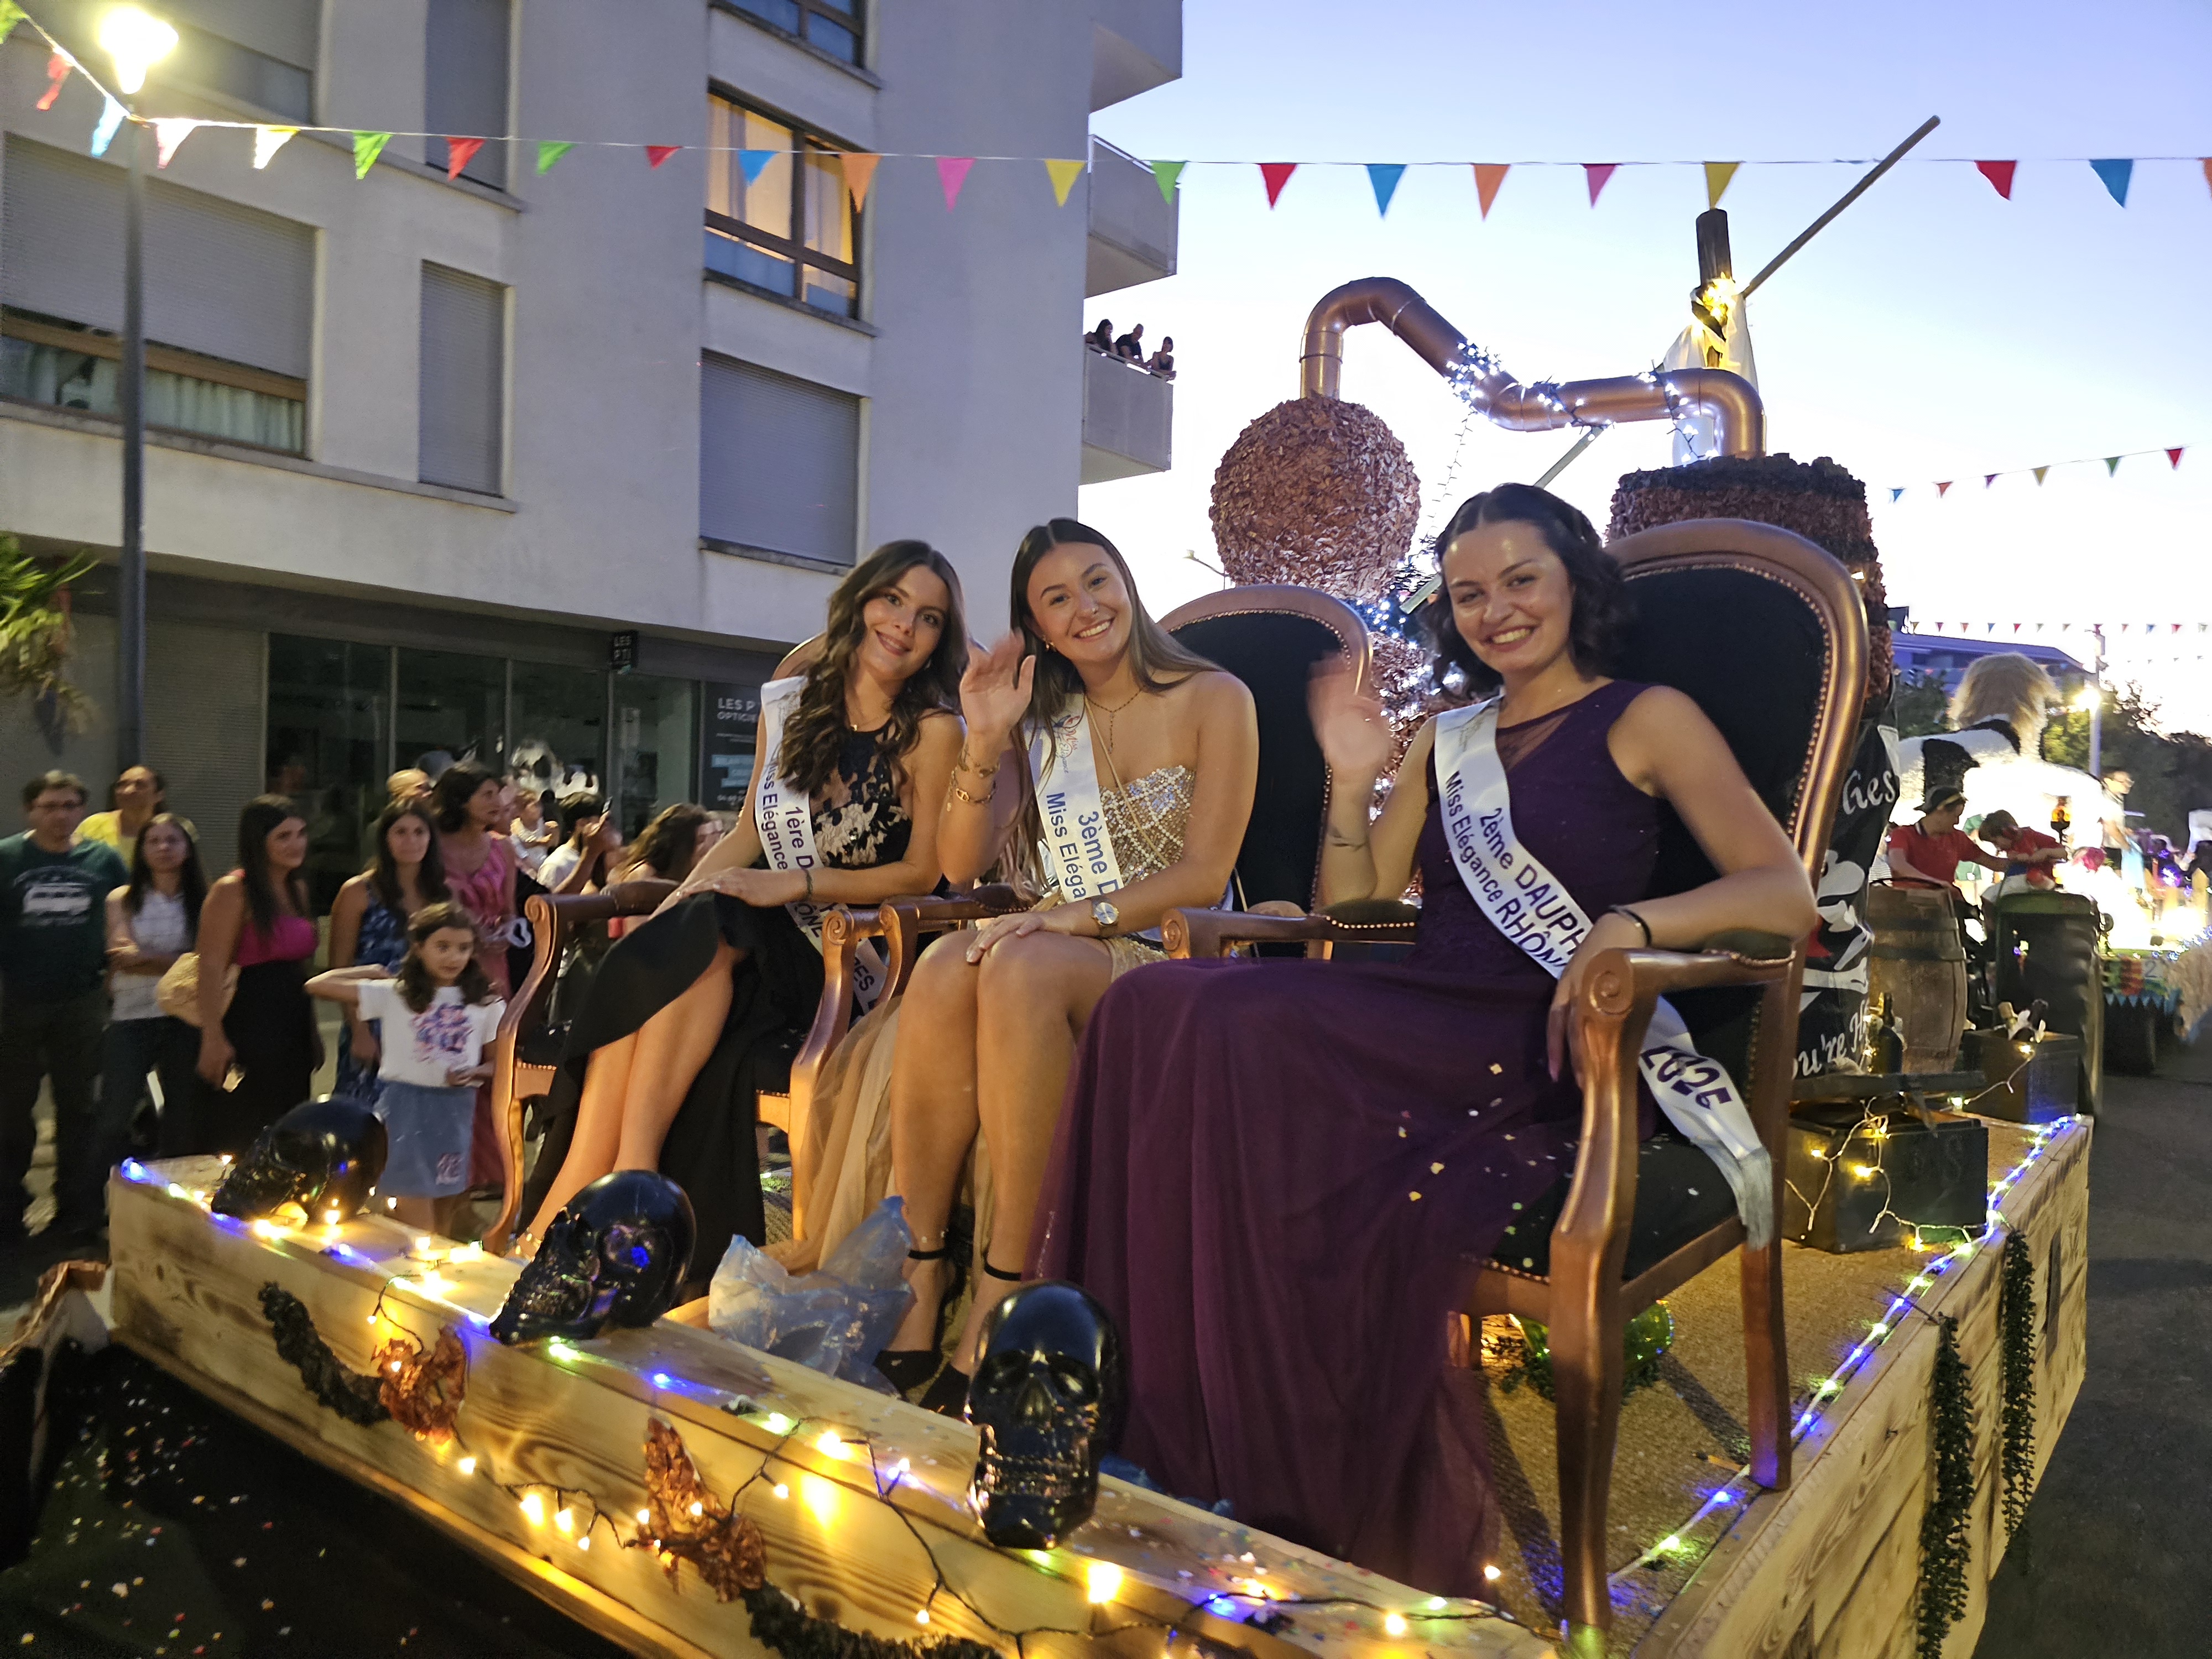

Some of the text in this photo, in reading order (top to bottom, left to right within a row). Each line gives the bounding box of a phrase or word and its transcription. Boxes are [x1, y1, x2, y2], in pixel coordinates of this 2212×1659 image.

[718, 697, 743, 711] LES
[761, 763, 789, 870] iss Elégance
[785, 806, 815, 869] 1ère D
[1046, 792, 1087, 899] Miss Eléga
[1078, 811, 1119, 895] 3ème D
[1445, 770, 1567, 967] Miss Elégance RHÔN
[1479, 807, 1585, 956] 2ème DAUPH
